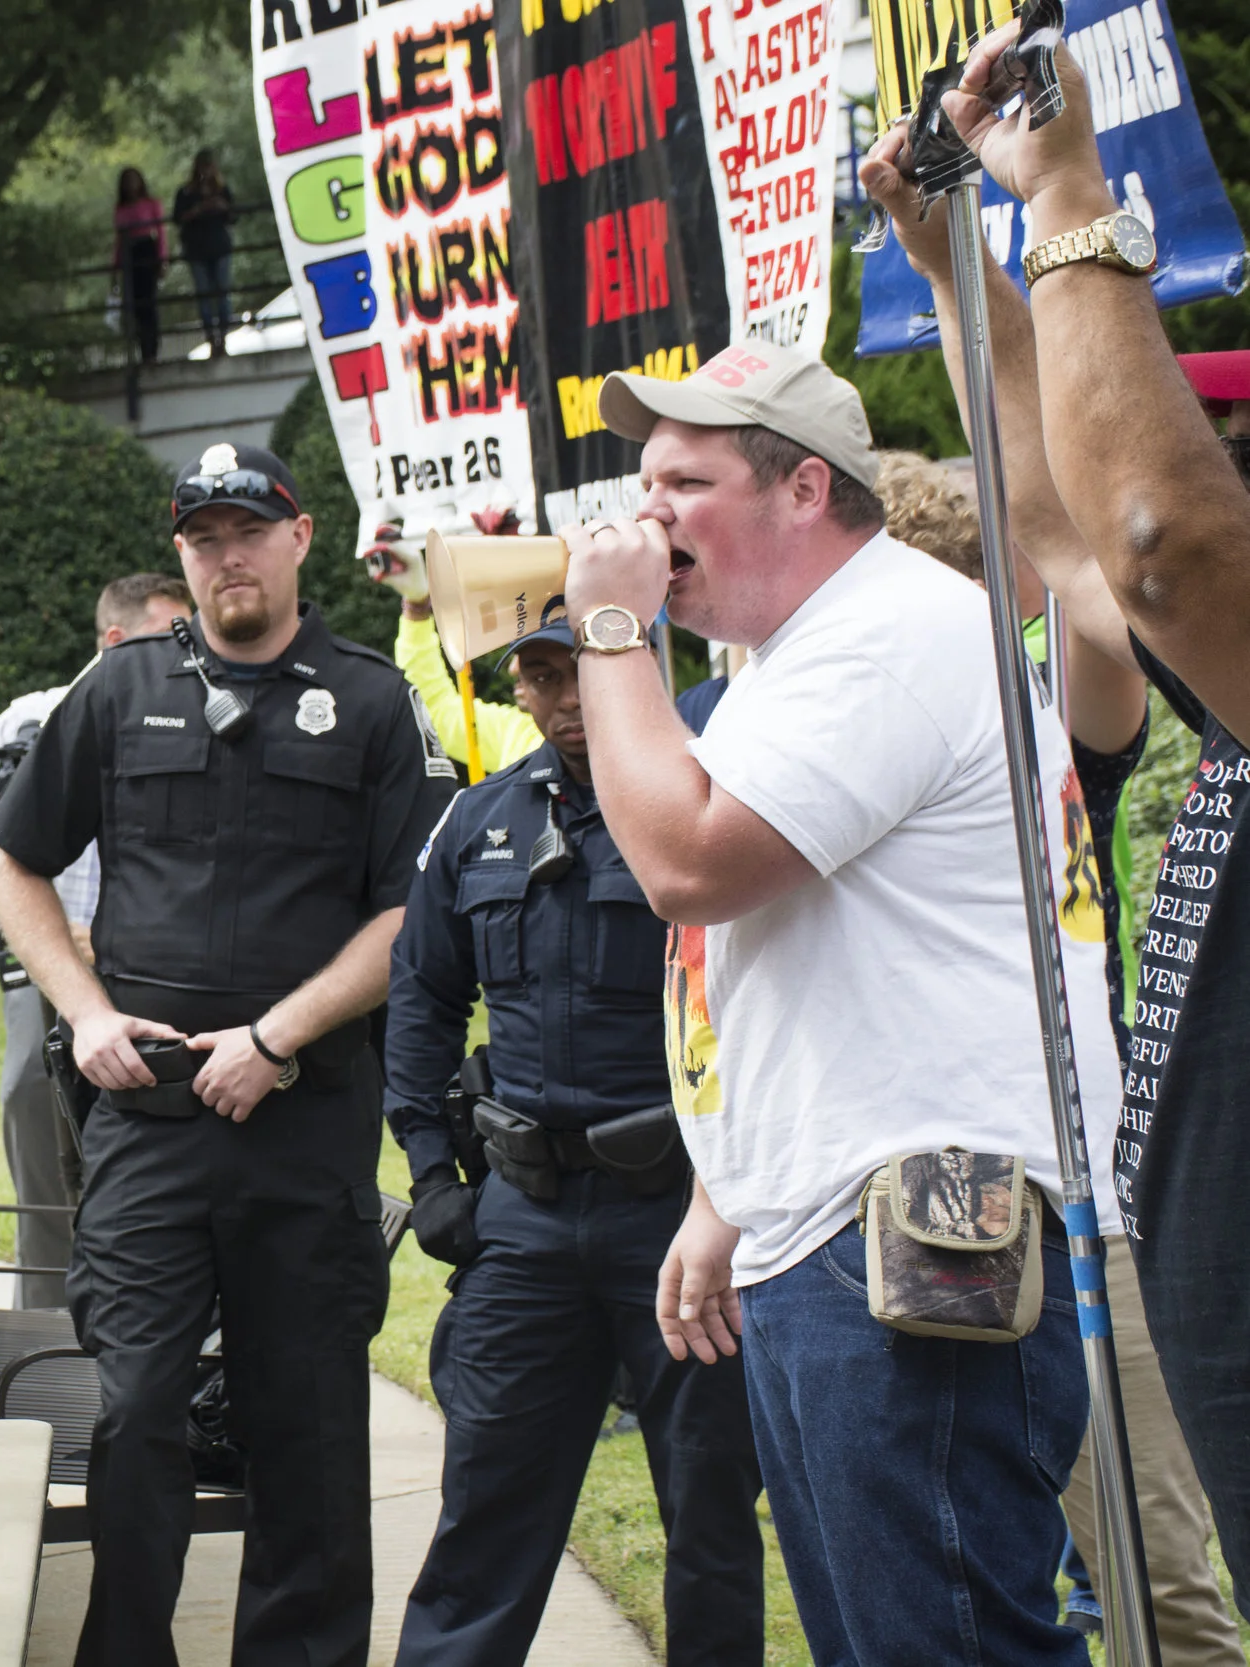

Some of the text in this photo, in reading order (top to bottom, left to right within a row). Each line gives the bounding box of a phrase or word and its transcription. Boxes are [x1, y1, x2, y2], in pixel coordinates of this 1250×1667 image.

[364, 4, 497, 130] LET
[372, 104, 509, 219] GOD
[386, 205, 519, 327] URN
[401, 312, 528, 424] HEM
[143, 715, 186, 729] PERKINS
